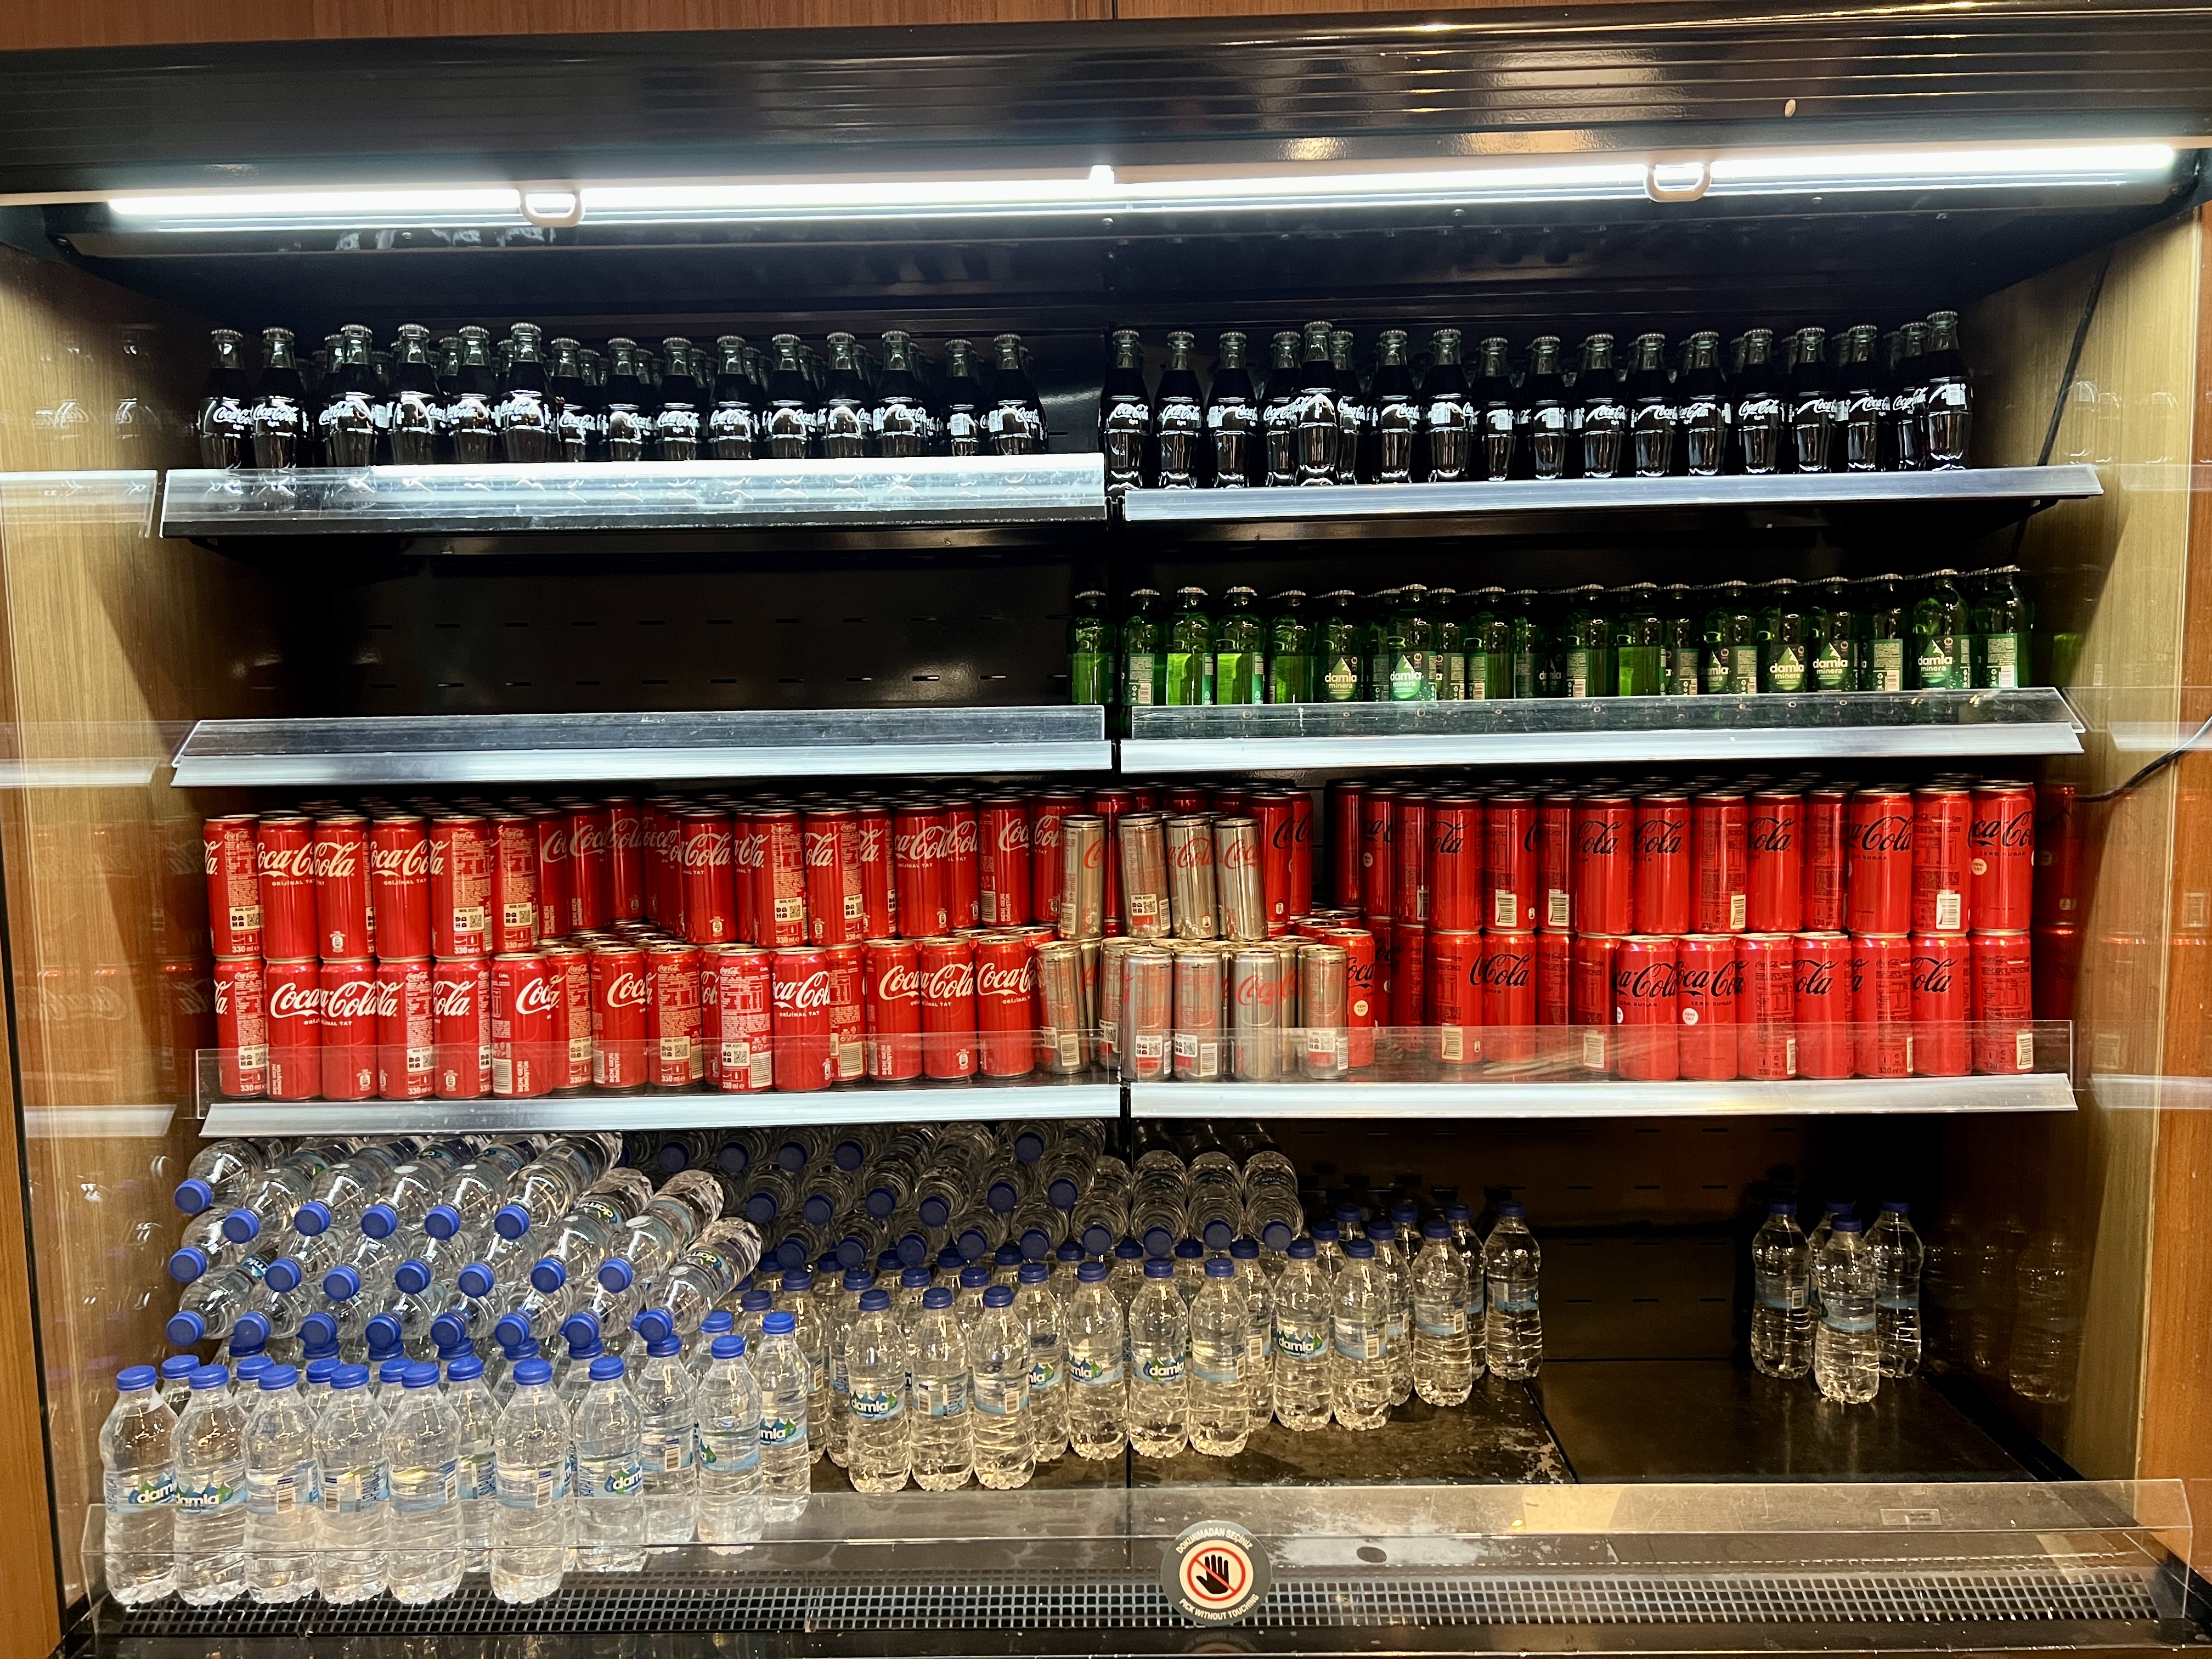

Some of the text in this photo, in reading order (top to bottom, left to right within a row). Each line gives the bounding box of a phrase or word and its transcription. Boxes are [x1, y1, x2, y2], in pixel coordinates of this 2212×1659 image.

[1813, 658, 1848, 669] damla
[1918, 655, 1953, 666] damla
[1769, 663, 1804, 674] damla
[1324, 673, 1357, 684] damla
[1390, 670, 1423, 681] damla
[408, 1087, 421, 1095] 330
[1279, 1338, 1314, 1352] damla
[1149, 1361, 1184, 1376] damla
[851, 1397, 888, 1412] damla
[760, 1428, 786, 1440] mla
[613, 1468, 642, 1489] dam
[1176, 1527, 1253, 1554] DOKUNMADAN SEÇİNİZ
[1179, 1594, 1260, 1620] PICK WITHOUT TOUCHING
